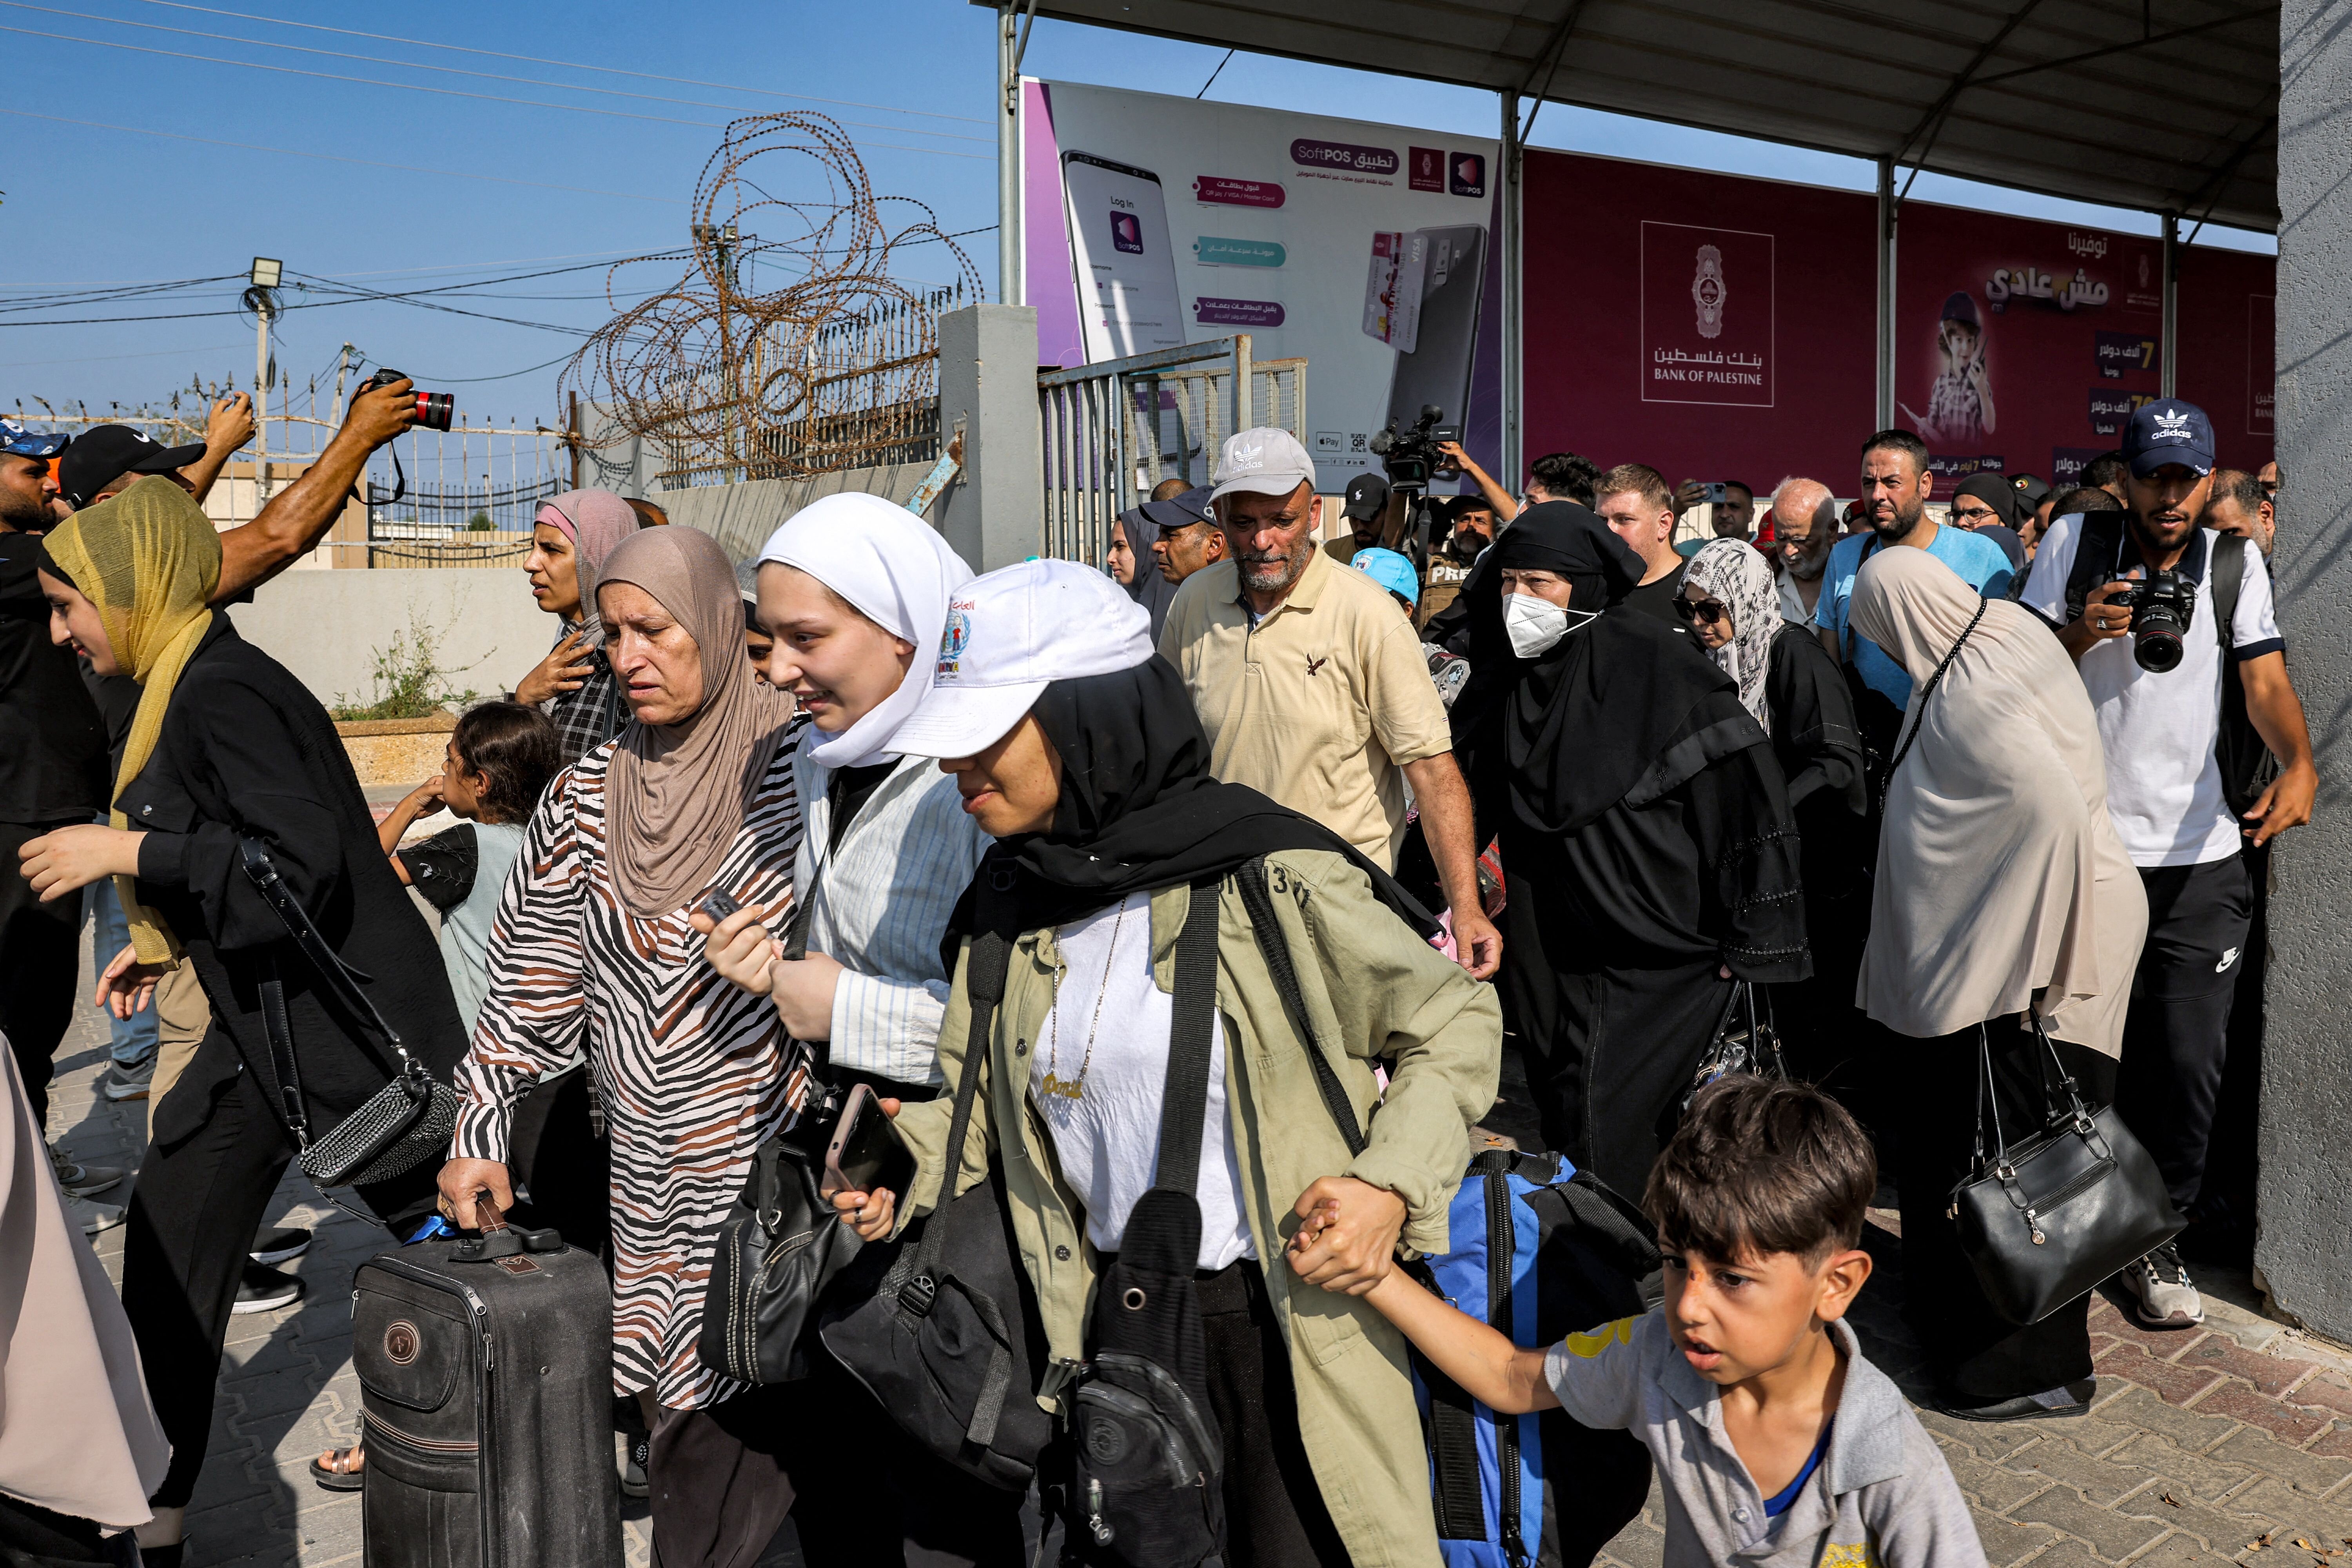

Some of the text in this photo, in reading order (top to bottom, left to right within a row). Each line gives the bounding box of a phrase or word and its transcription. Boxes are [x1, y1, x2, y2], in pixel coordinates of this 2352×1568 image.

[1298, 146, 1393, 169] تطبيق SoftPOS
[1217, 181, 1243, 189] بطاقات
[1455, 185, 1481, 194] SoftPOS
[1111, 196, 1134, 209] Log In
[1118, 242, 1141, 251] SoftPOS
[1411, 238, 1421, 262] VISA
[2068, 232, 2107, 259] توفيرنا
[1985, 266, 2109, 312] مش عادي
[1205, 301, 1230, 311] بعملات
[1231, 303, 1262, 312] البطاقات
[1654, 347, 1762, 370] بنك فلسطين
[2099, 341, 2154, 368] 7 آلاف دولار
[1654, 368, 1762, 385] BANK OF PALESTINE
[2091, 400, 2113, 414] دولار
[2114, 398, 2130, 414] ألف
[2151, 428, 2192, 440] adidas
[1326, 437, 1339, 447] Pay
[1232, 461, 1263, 473] adidas
[1945, 461, 1958, 475] في
[1959, 459, 1972, 473] أيام
[1973, 460, 1980, 471] 7
[2055, 457, 2081, 474] دولار
[1431, 566, 1474, 583] PRE
[1545, 622, 1557, 630] KN95
